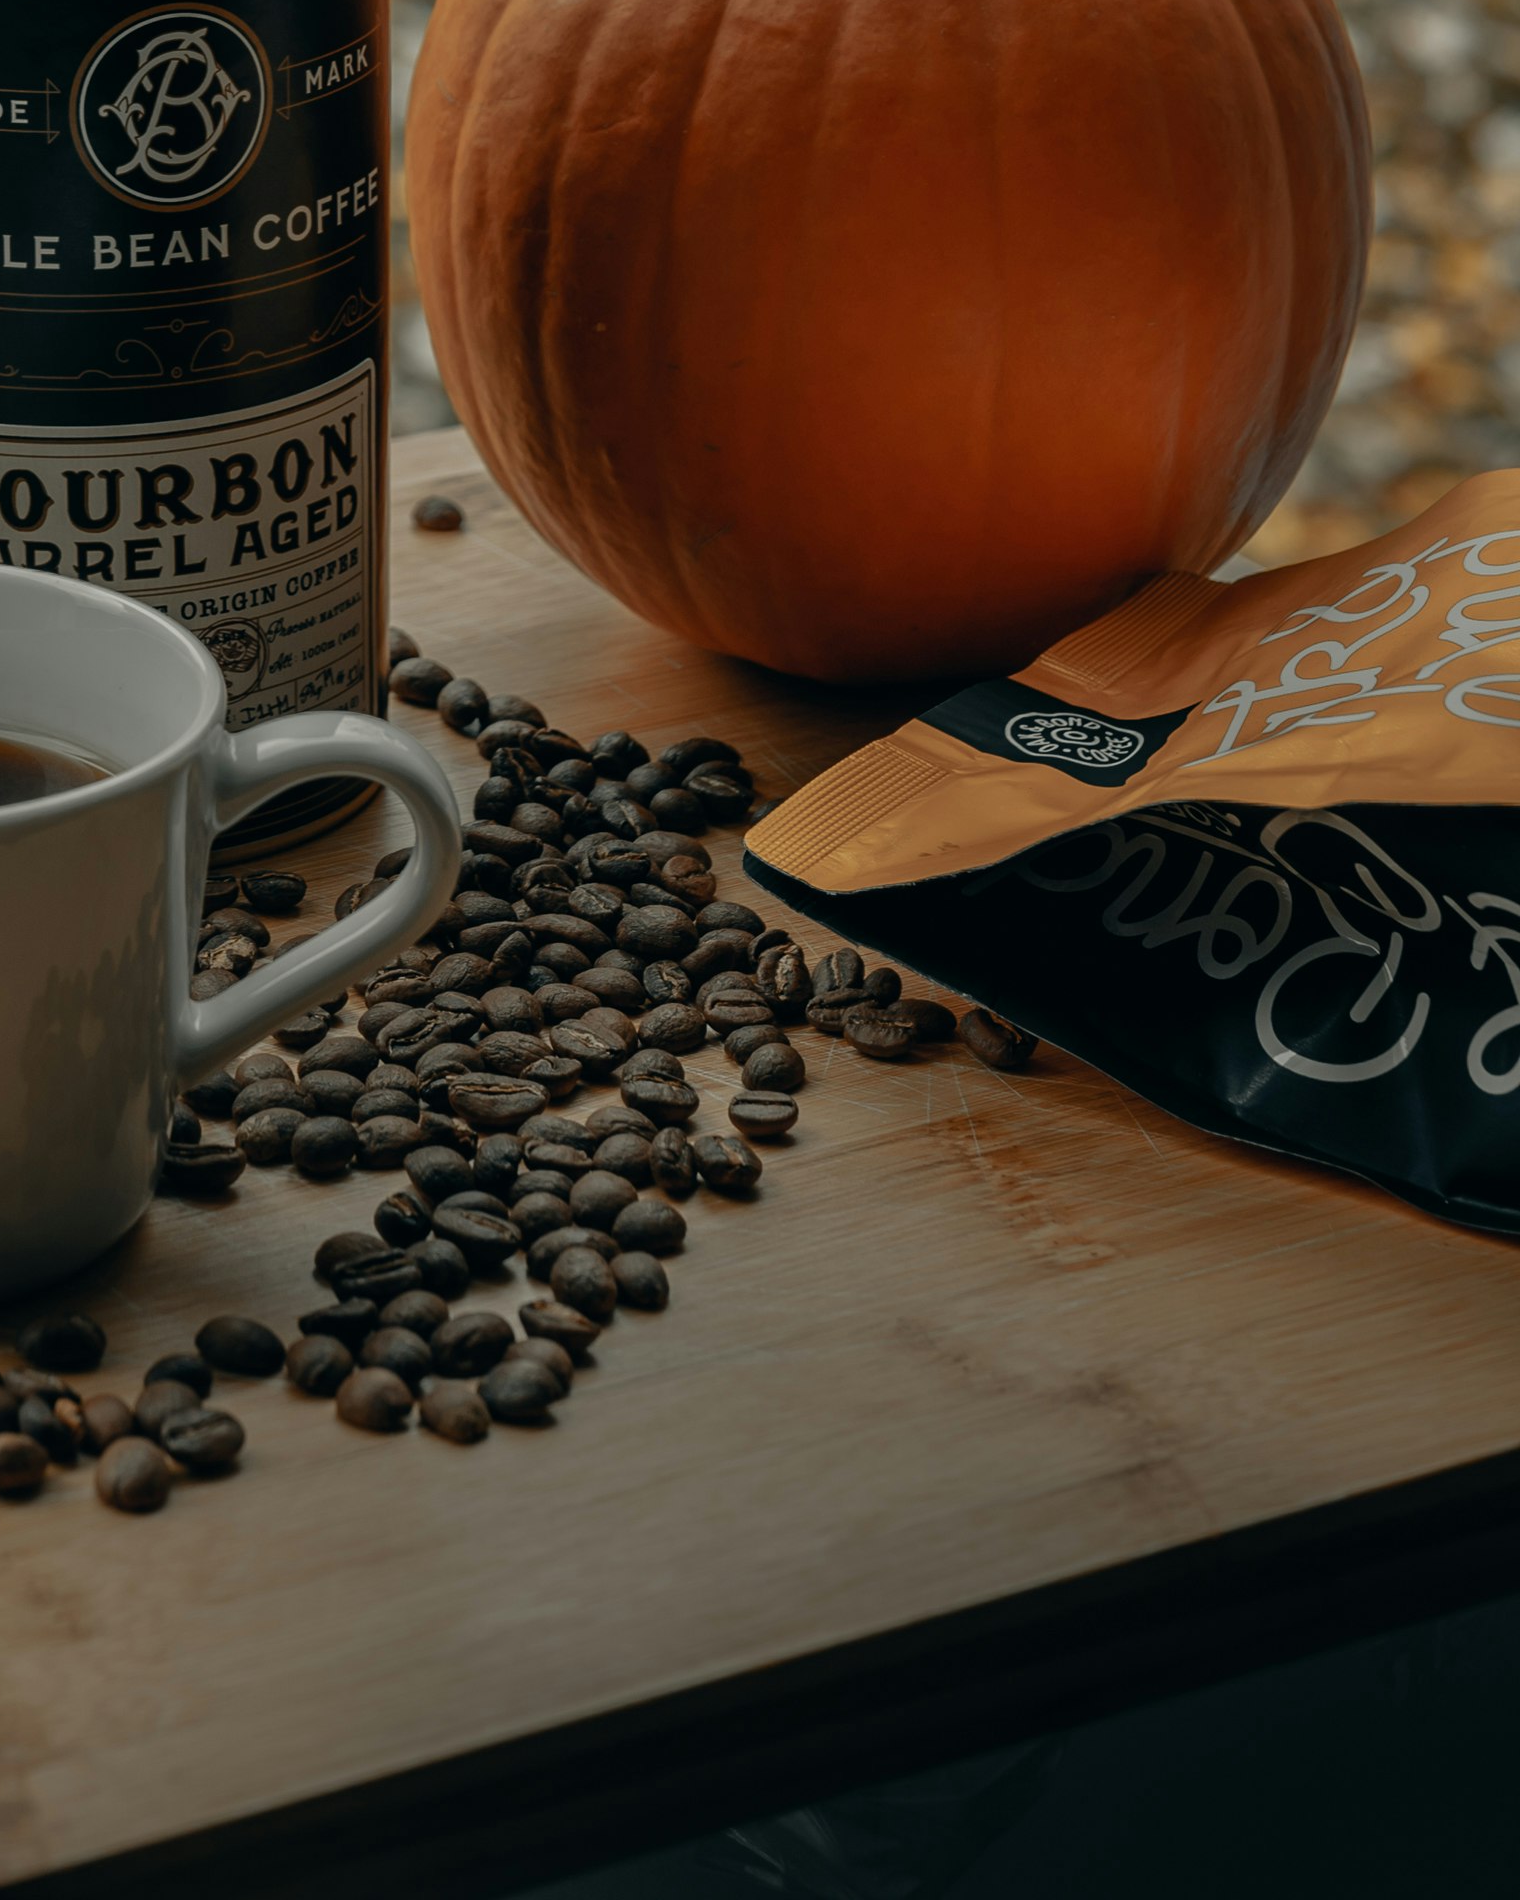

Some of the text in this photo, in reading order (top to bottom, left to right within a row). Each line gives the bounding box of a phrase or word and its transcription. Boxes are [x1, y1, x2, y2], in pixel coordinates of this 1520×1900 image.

[305, 44, 369, 95] MARK
[92, 223, 230, 271] BEAN
[252, 167, 379, 251] COFFEE
[229, 484, 359, 567] AGED
[180, 547, 359, 620] ORIGIN COFFEE
